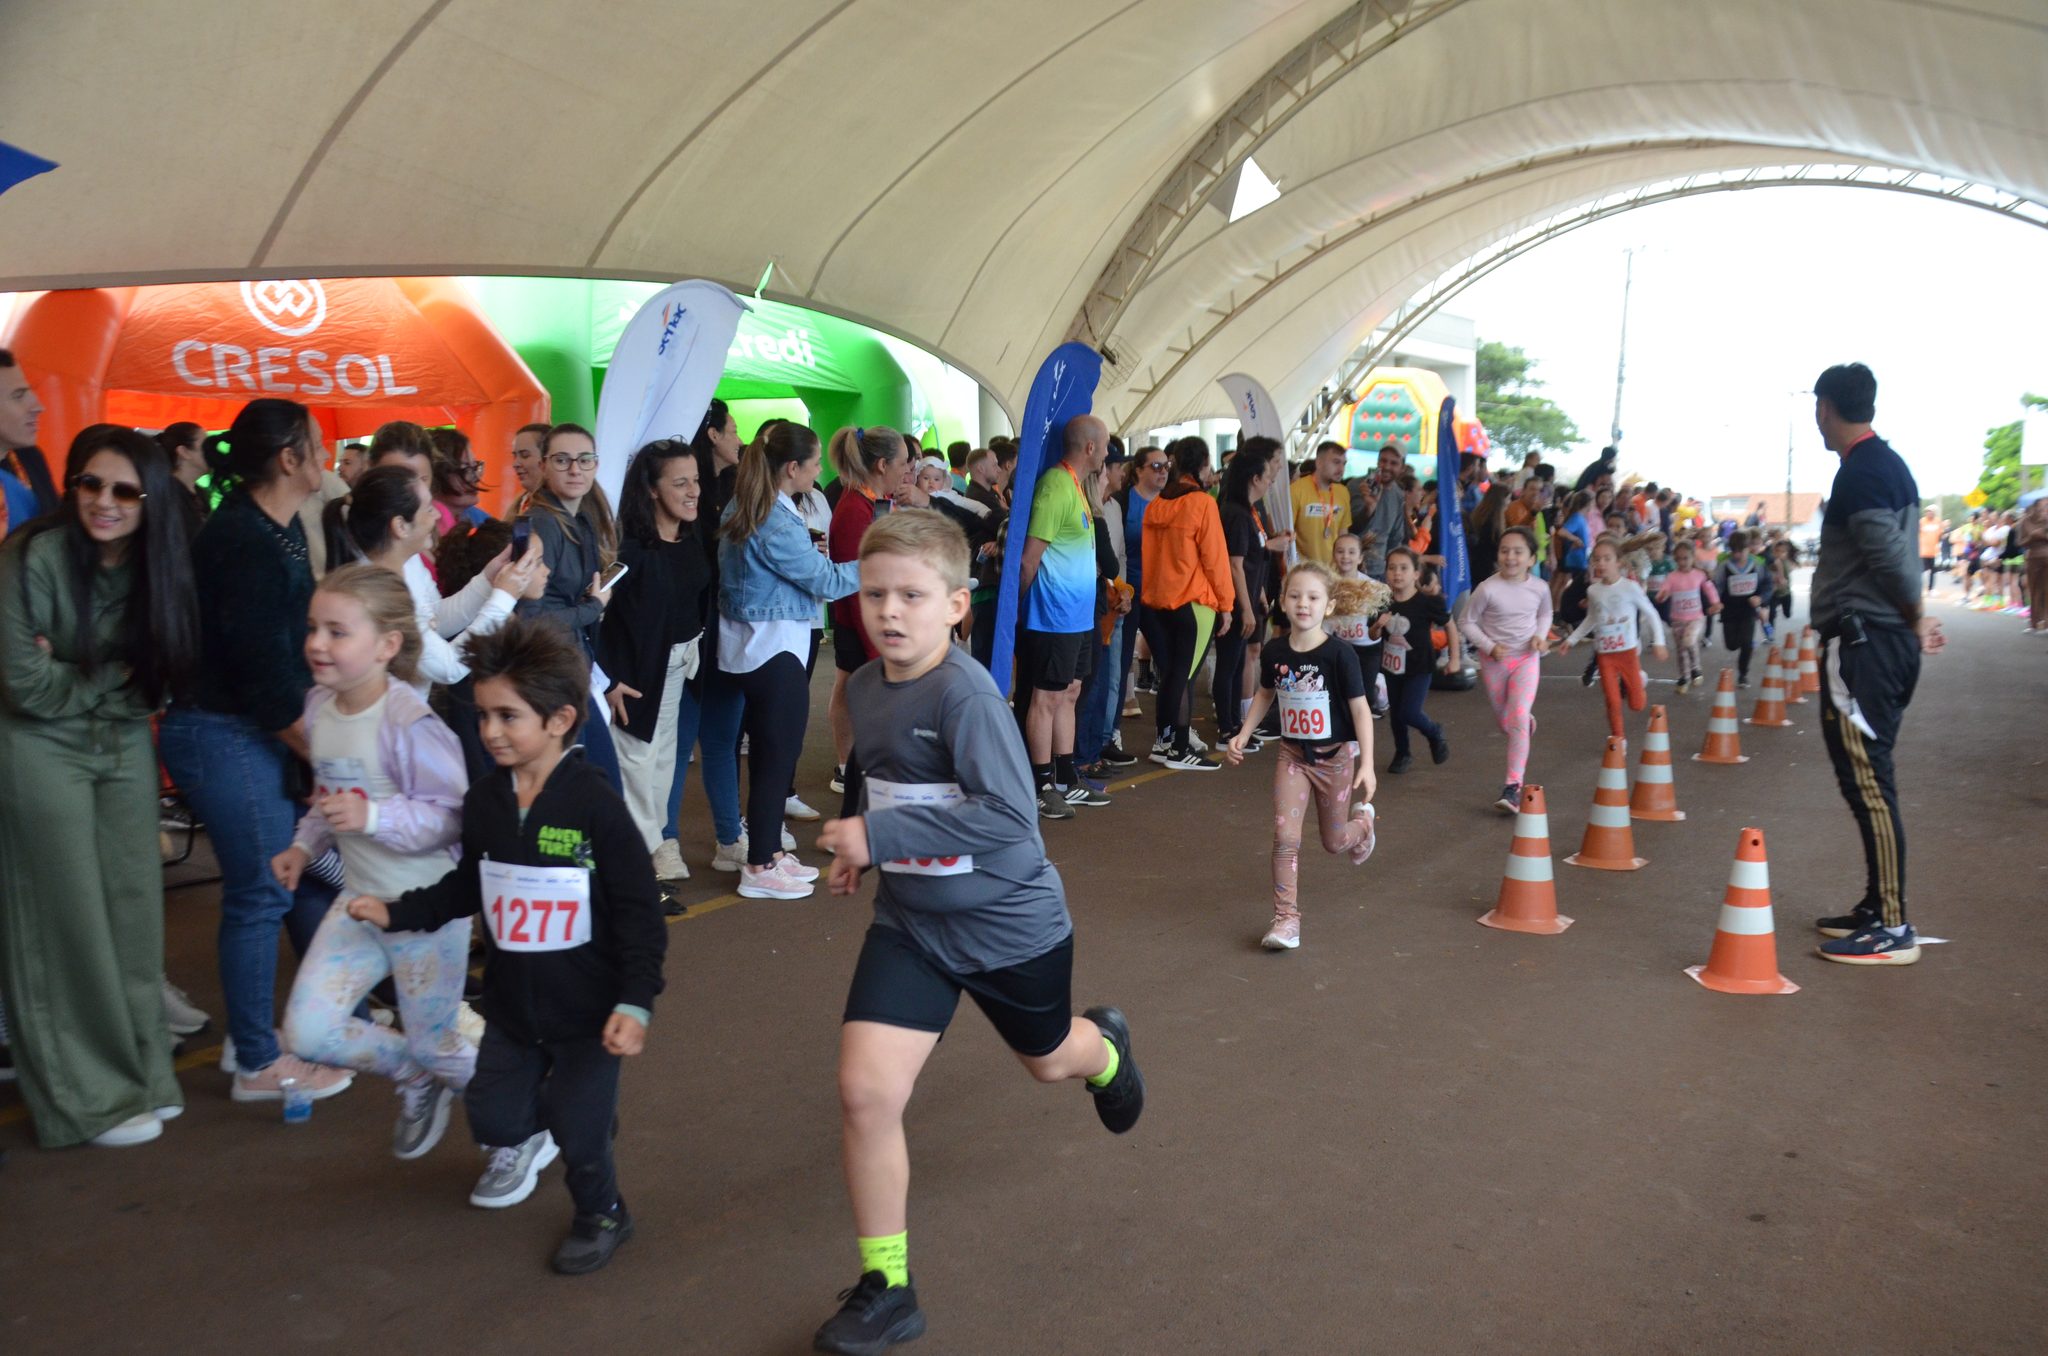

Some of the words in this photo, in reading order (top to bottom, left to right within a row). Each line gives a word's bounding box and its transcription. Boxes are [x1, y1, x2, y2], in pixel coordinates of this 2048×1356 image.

[171, 339, 418, 397] CRESOL
[1281, 708, 1325, 735] 1269
[491, 895, 579, 943] 1277
